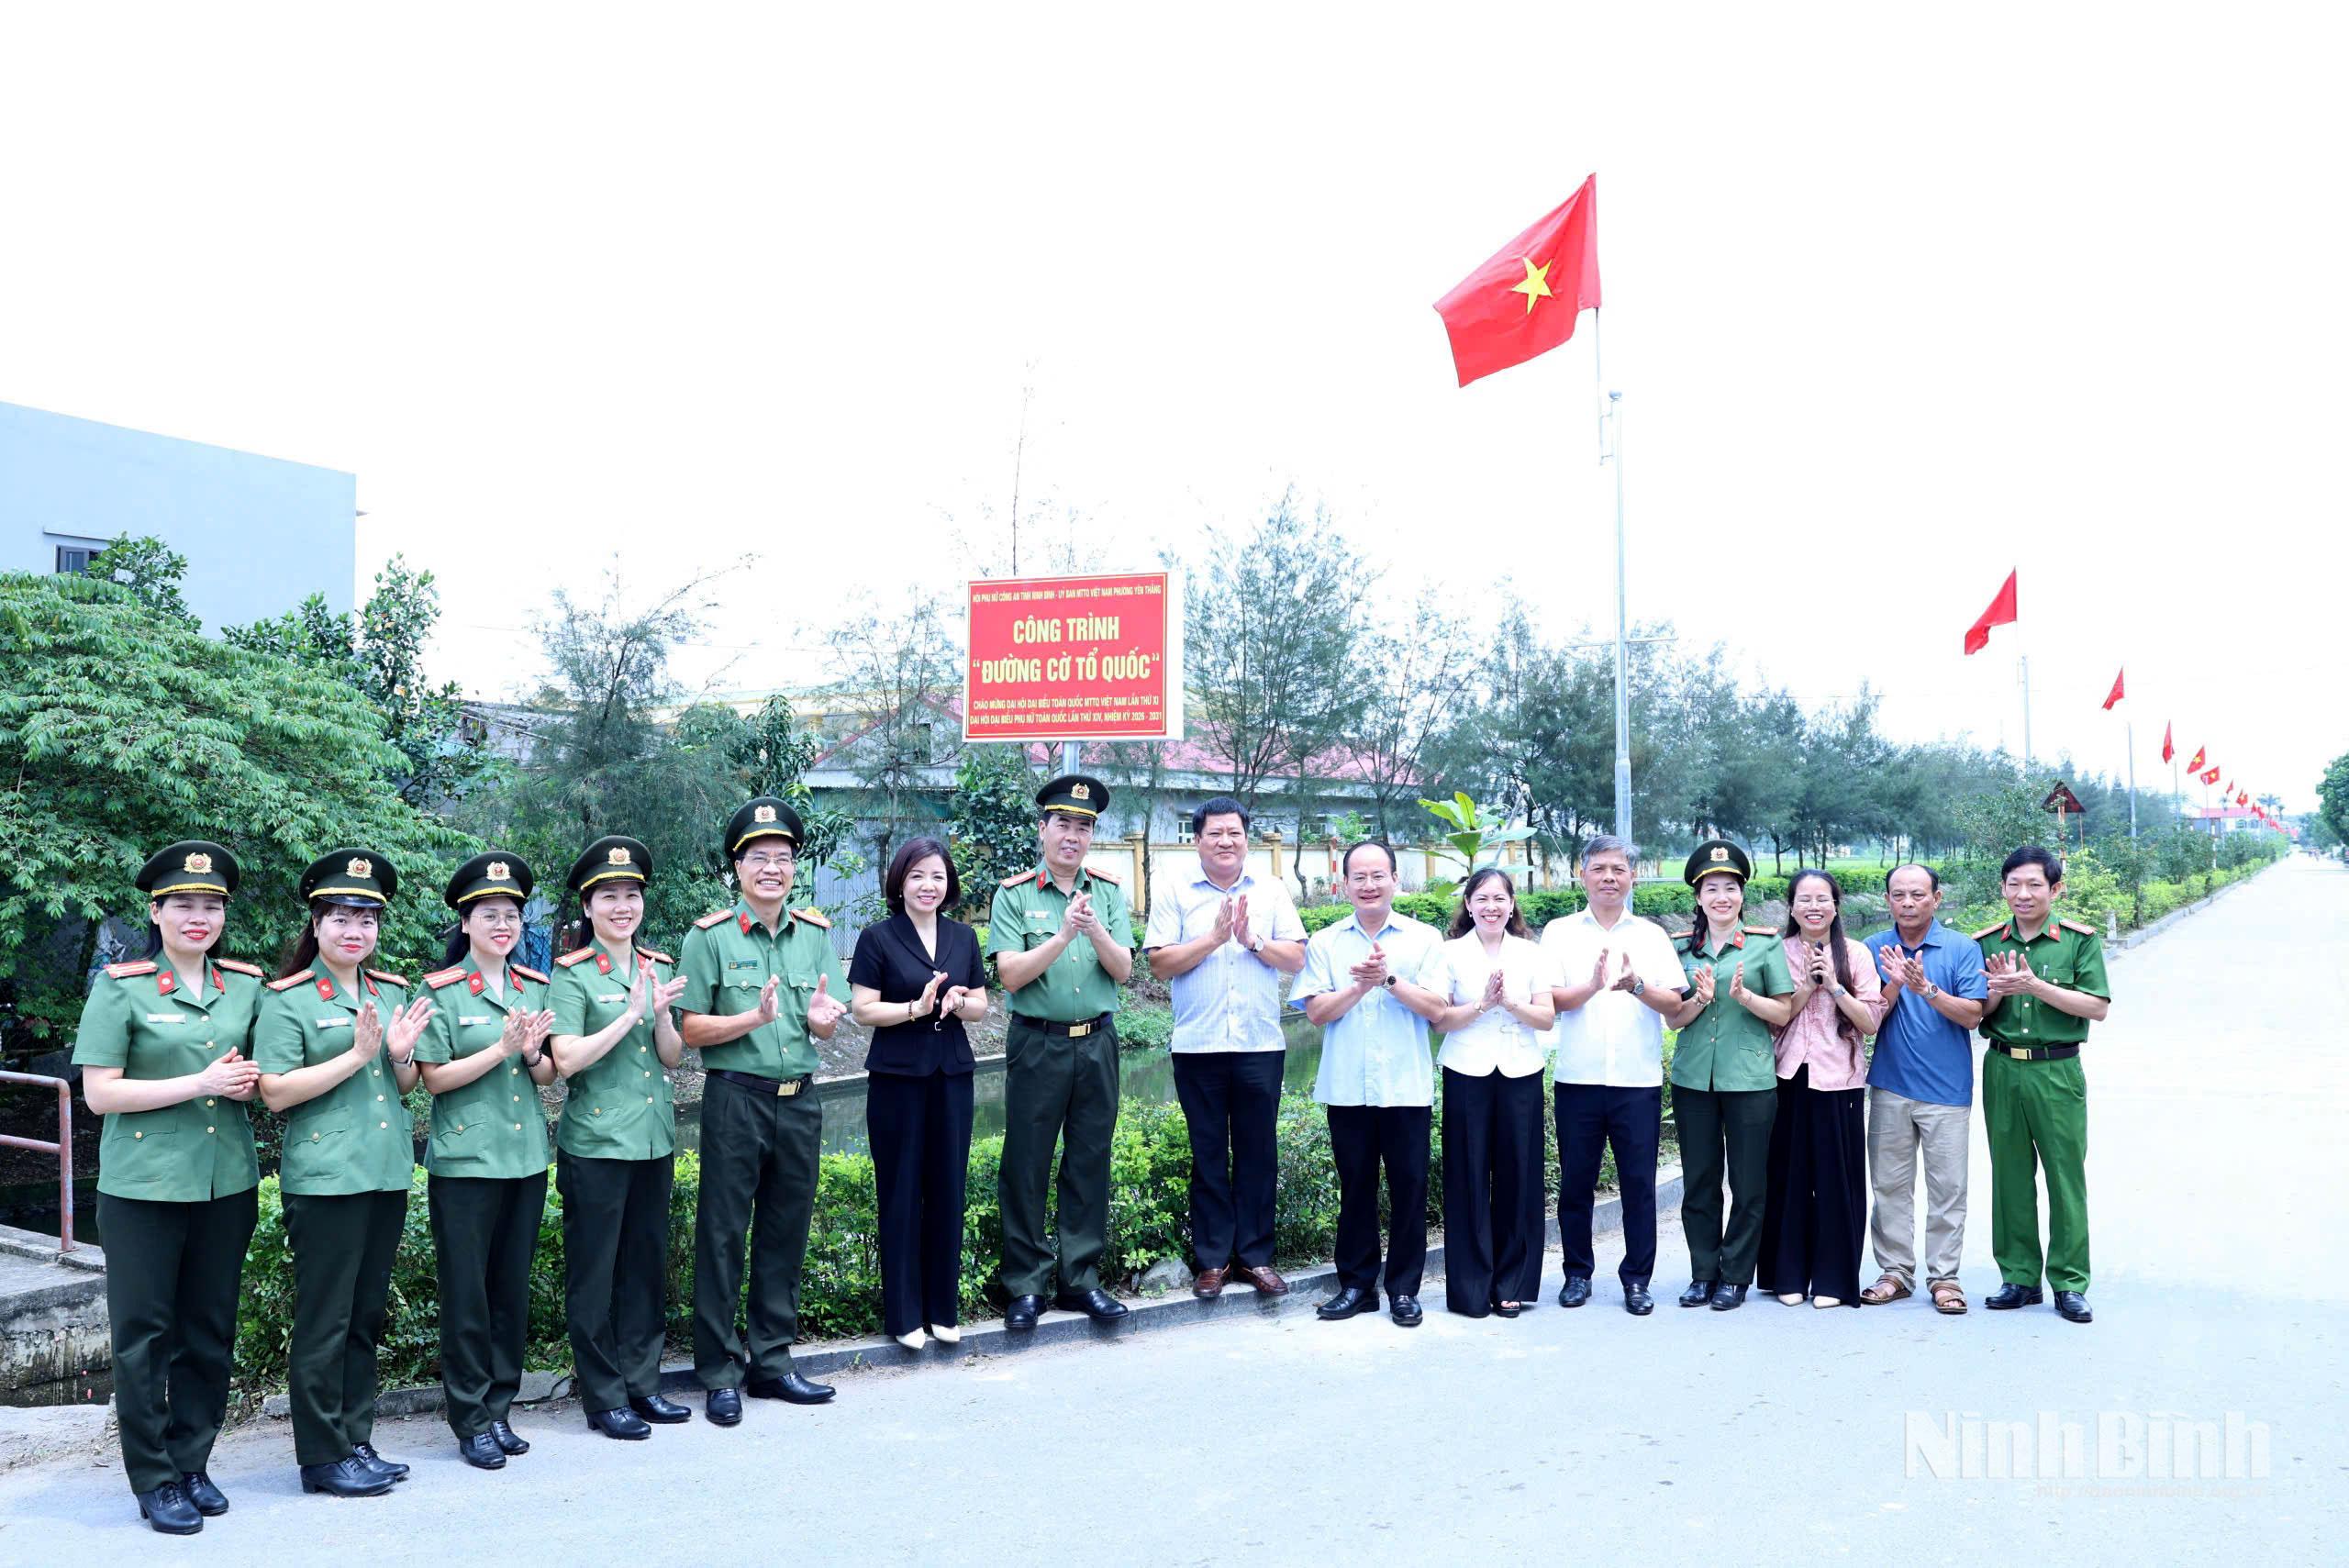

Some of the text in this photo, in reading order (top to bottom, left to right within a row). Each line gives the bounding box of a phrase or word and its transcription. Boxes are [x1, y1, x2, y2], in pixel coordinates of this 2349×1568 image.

[999, 591, 1012, 602] CÔNG
[1013, 592, 1020, 601] AN
[1101, 587, 1113, 596] NAM
[1013, 612, 1119, 644] CÔNG TRÌNH
[1046, 651, 1072, 681] CỜ
[1075, 647, 1098, 681] TỔ
[974, 697, 988, 710] CHÀO
[989, 697, 1006, 709] MỪNG
[1007, 700, 1016, 712] ĐẠI
[1017, 697, 1026, 710] HỘI
[1052, 695, 1066, 708] TOÀN
[1068, 694, 1083, 708] QUỐC
[1085, 697, 1099, 708] MTTQ
[1101, 695, 1112, 708] VIỆT
[1114, 696, 1127, 706] NAM
[1128, 692, 1140, 706] LẦN
[1141, 694, 1152, 706] THỨ
[1152, 695, 1159, 706] XI
[970, 715, 980, 727] ĐẠI
[980, 713, 989, 727] HỘI
[991, 715, 1000, 727] ĐẠI
[1015, 714, 1026, 726] PHỤ
[1026, 712, 1035, 723] NỮ
[1036, 712, 1051, 723] TOÀN
[1052, 709, 1066, 723] QUỐC
[1068, 710, 1079, 722] LẦN
[1081, 710, 1091, 722] THỨ
[1104, 710, 1121, 723] NHIỆM
